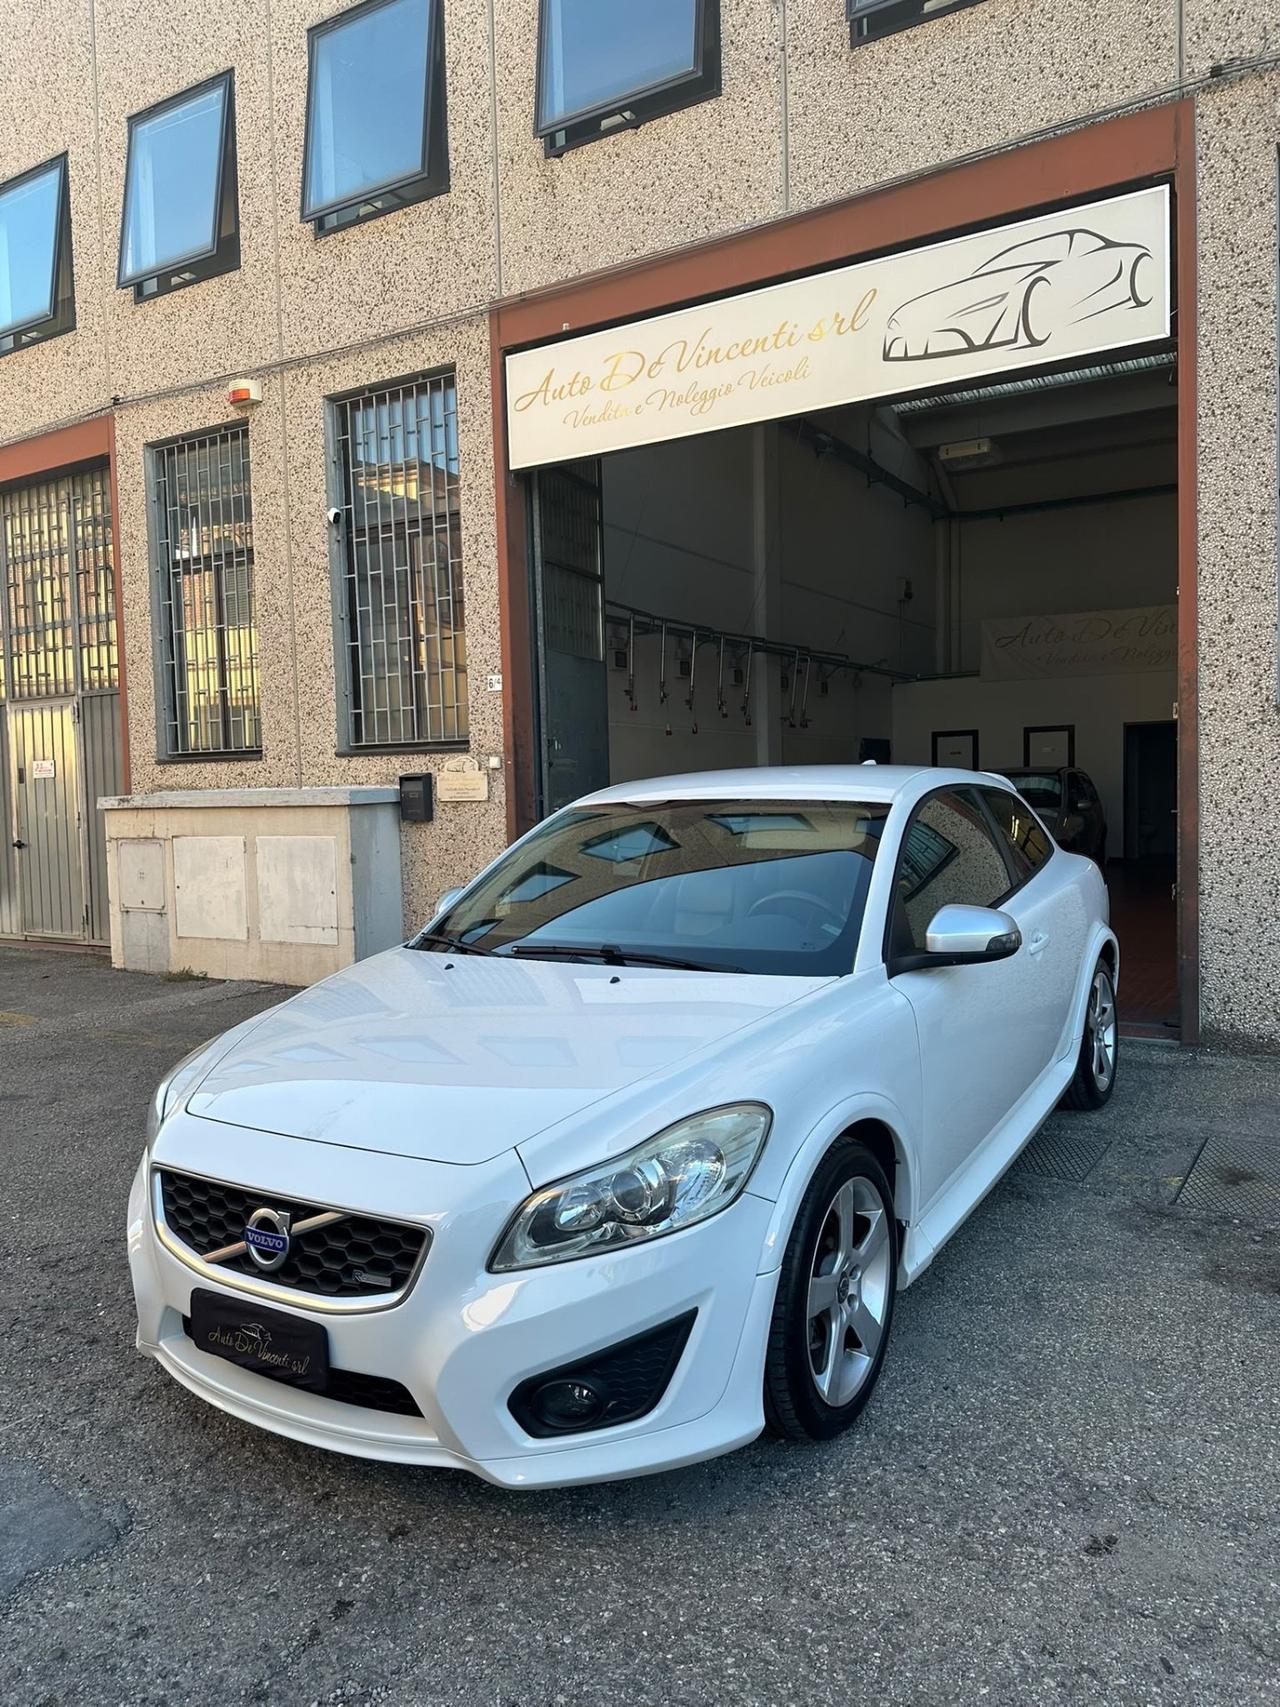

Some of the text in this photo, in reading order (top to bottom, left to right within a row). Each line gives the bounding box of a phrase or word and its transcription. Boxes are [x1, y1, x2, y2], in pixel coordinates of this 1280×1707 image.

[514, 287, 878, 412] Auto De Vincenti srl
[562, 356, 812, 430] Vendita e Noleggio Veicoli
[994, 621, 1066, 649] Auto
[246, 1231, 284, 1250] VOLVO
[208, 1325, 234, 1346] Auto
[253, 1340, 290, 1369] Vincenti
[291, 1355, 310, 1376] srl
